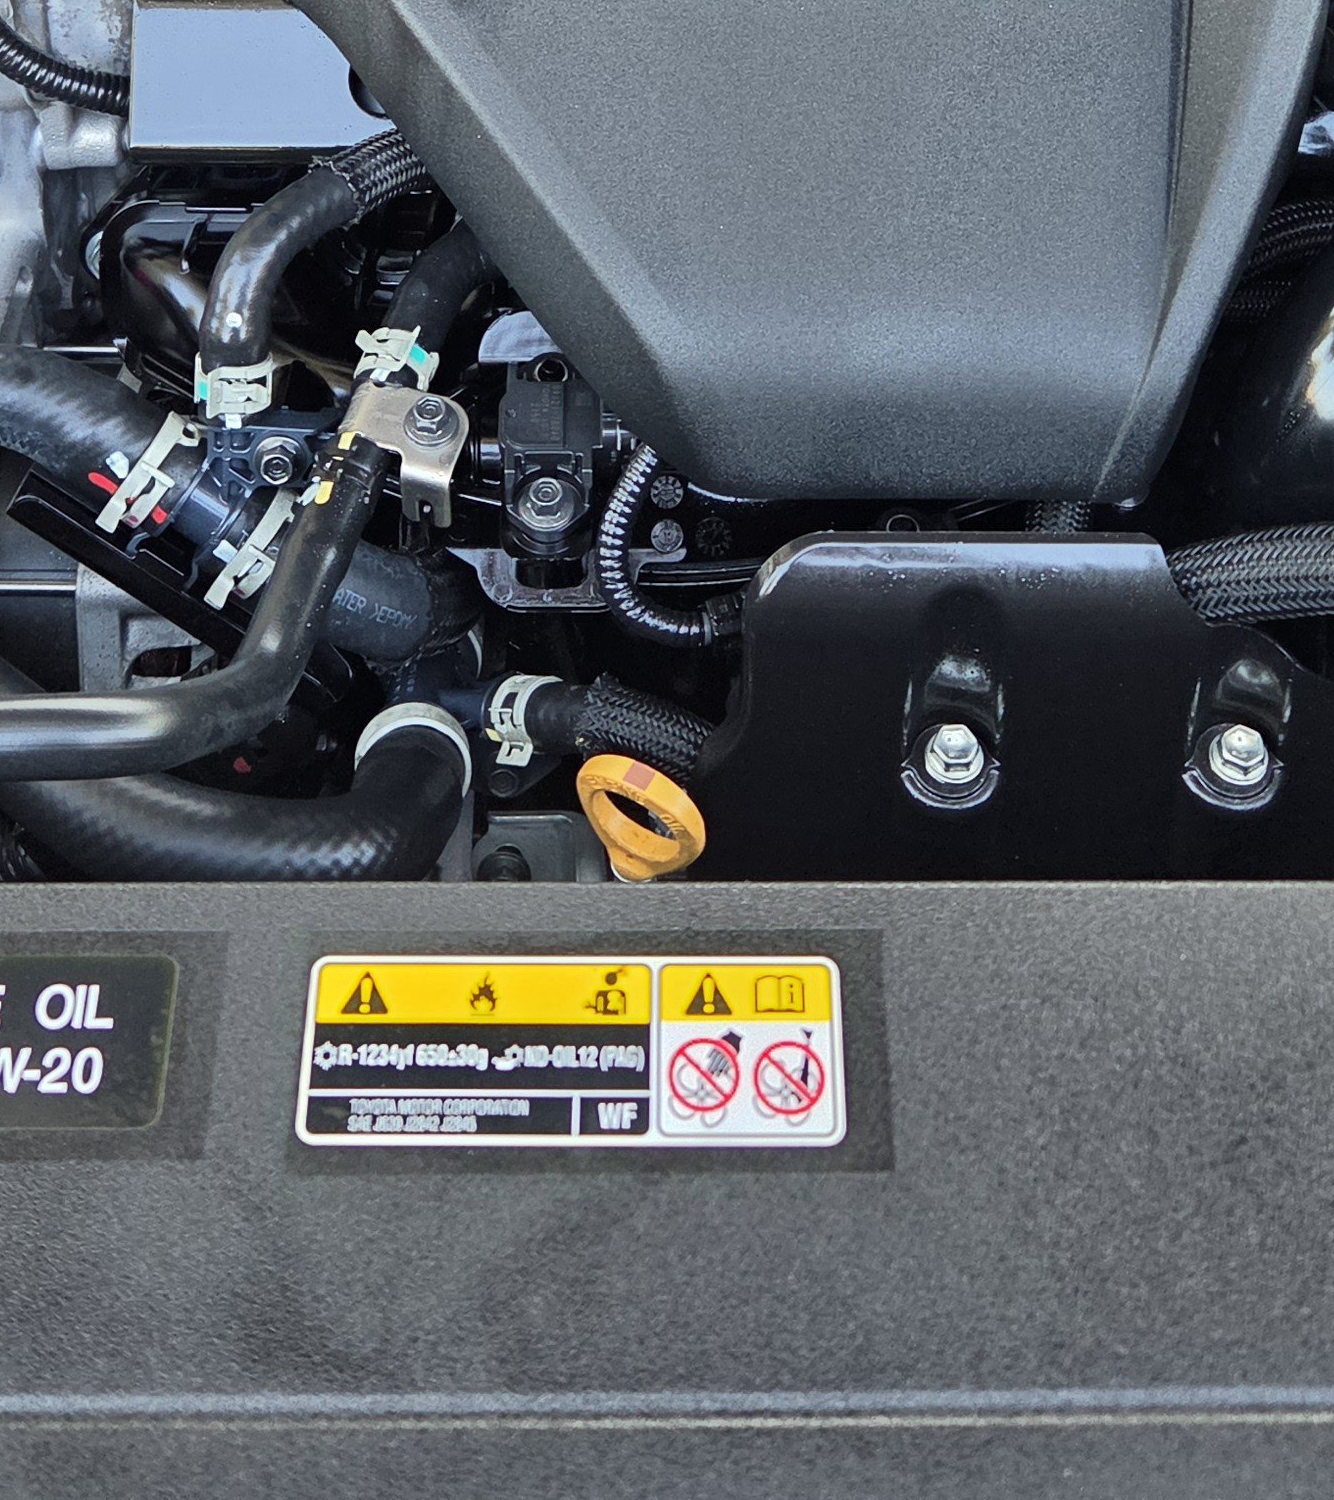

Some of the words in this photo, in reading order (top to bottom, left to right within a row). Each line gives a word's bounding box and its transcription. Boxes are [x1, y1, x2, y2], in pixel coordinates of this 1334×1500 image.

[331, 587, 368, 615] ATER
[34, 982, 115, 1031] OIL
[349, 1098, 398, 1115] TOYOTA
[398, 1098, 443, 1116] MOTOR
[443, 1099, 531, 1117] CORPORATION
[597, 1101, 639, 1130] WF
